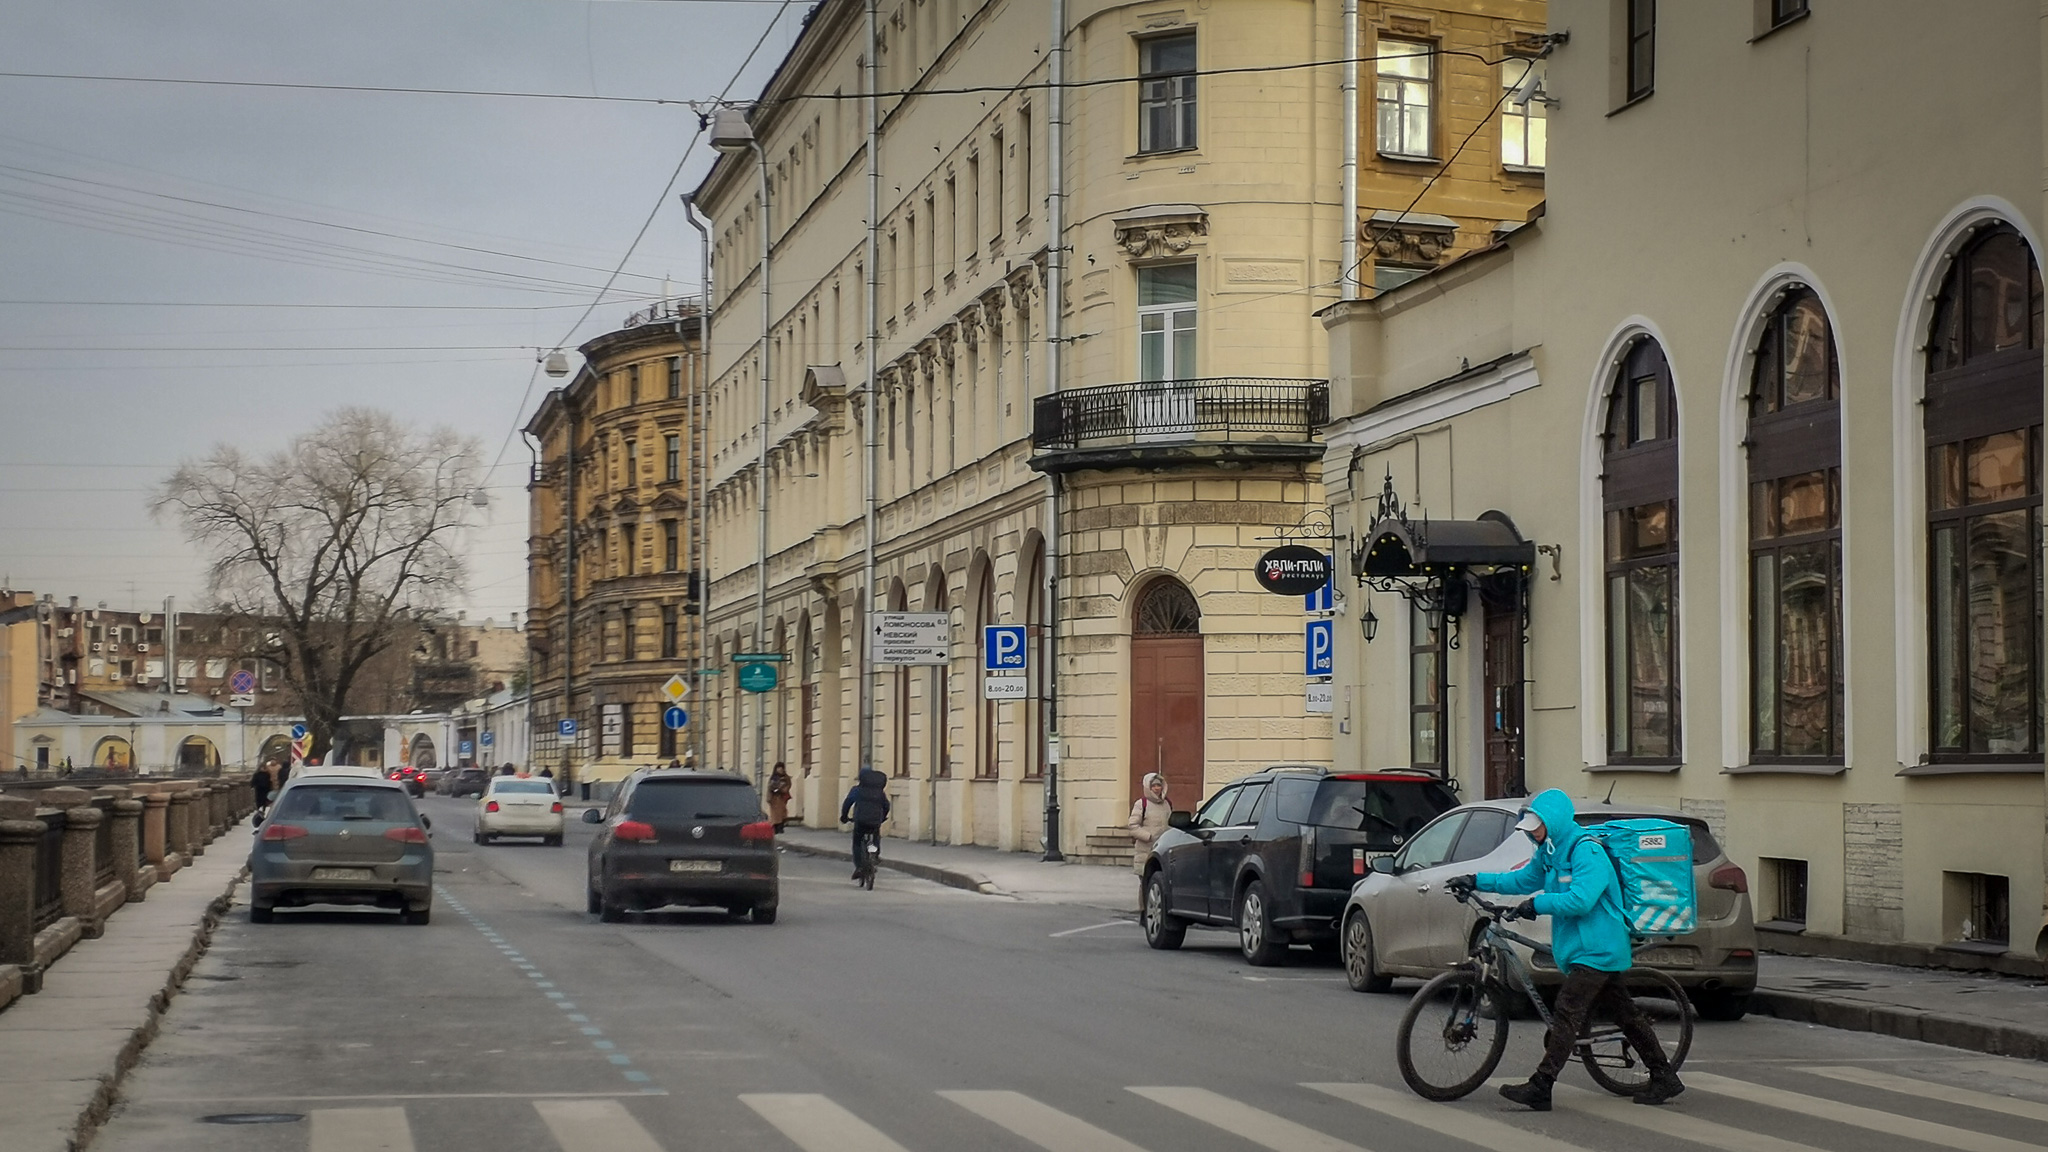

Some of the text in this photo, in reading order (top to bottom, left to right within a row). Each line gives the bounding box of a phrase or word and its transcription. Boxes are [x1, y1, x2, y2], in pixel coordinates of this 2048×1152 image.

[883, 647, 932, 655] БАНКОВСКИЙ
[996, 630, 1019, 665] P
[1312, 626, 1329, 670] P
